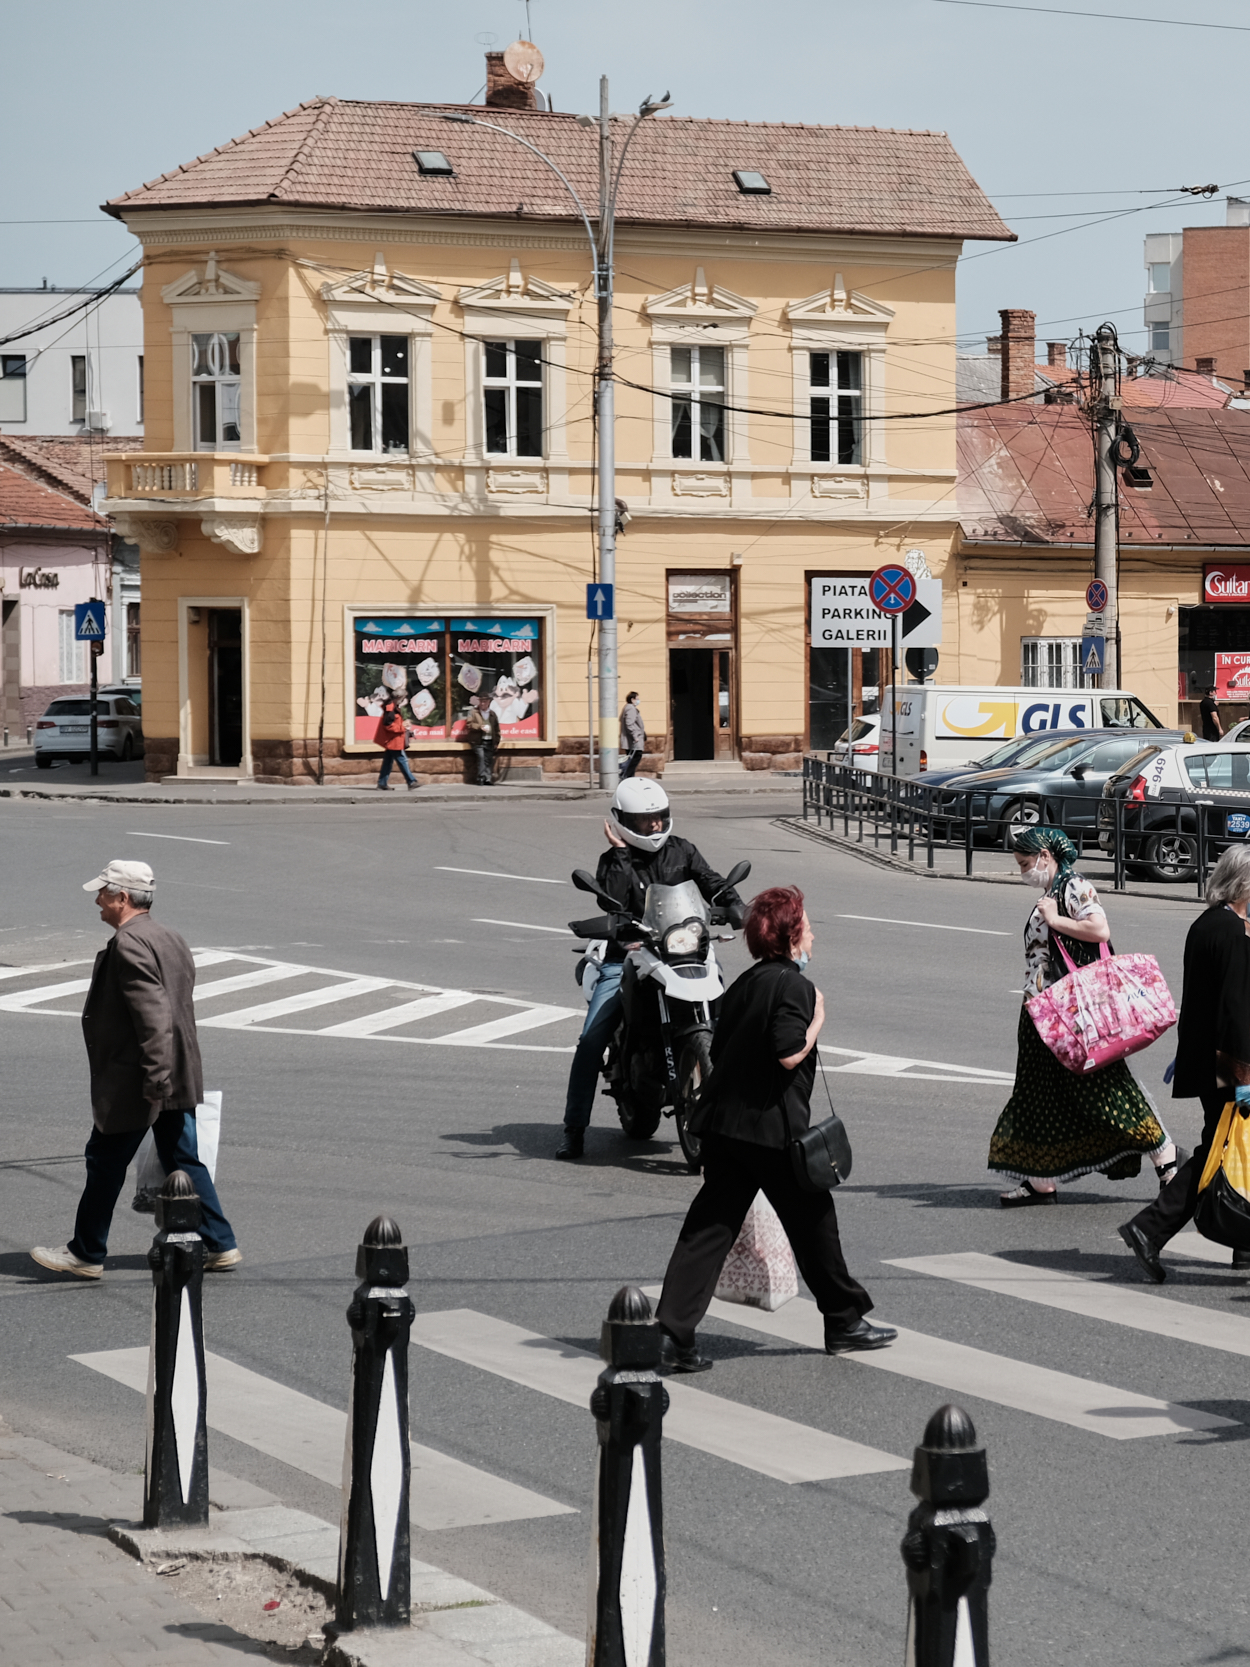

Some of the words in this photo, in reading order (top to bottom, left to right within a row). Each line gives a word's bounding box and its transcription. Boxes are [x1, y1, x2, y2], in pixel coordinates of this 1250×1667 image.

[822, 585, 868, 597] PIATA
[822, 629, 887, 641] GALERII
[362, 639, 438, 653] MARICARN
[458, 639, 532, 653] MARICARN
[1221, 654, 1231, 665] ÎN
[1021, 703, 1087, 735] GLS
[429, 728, 444, 736] mai
[1152, 758, 1166, 783] 949
[1231, 820, 1250, 829] 2539
